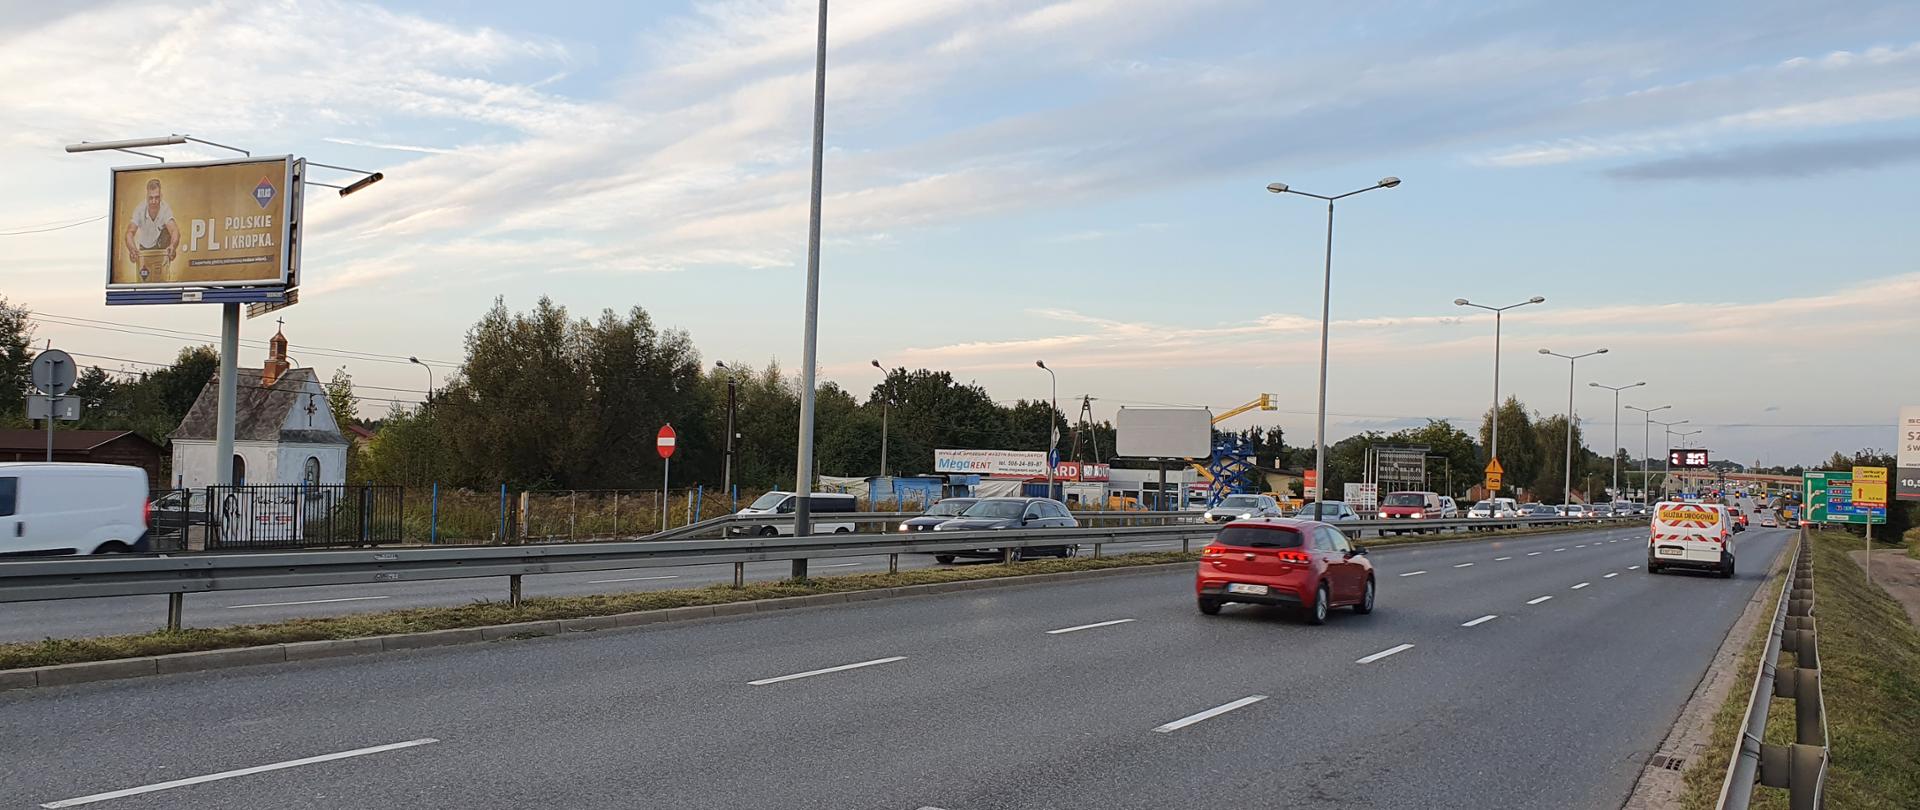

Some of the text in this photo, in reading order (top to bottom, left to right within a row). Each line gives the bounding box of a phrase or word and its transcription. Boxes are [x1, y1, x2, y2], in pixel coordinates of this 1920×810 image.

[225, 215, 272, 230] POLSKIE
[232, 233, 275, 248] KROPKA.
[1684, 512, 1714, 520] DROGOWA
